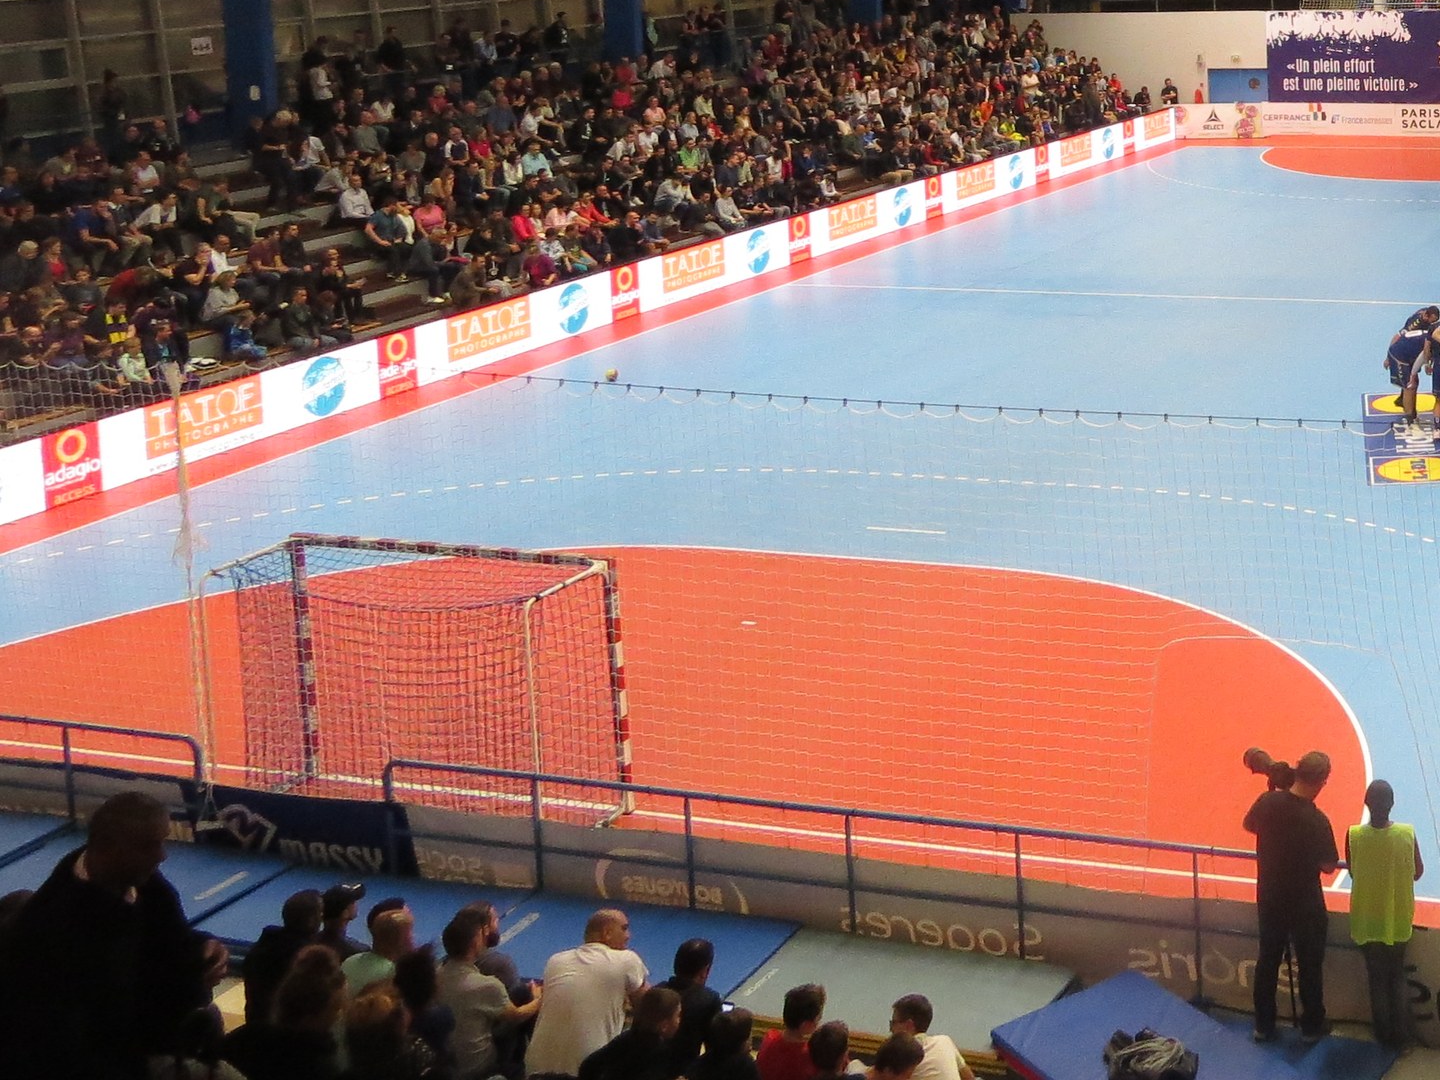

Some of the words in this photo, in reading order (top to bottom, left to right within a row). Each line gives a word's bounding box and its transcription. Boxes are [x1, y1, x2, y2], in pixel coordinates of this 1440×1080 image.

[1314, 58, 1341, 73] plein
[1344, 58, 1375, 73] effort
[1283, 77, 1299, 91] est
[1303, 78, 1323, 91] une
[1327, 76, 1360, 93] pleine
[1401, 108, 1440, 118] PARIS
[830, 198, 875, 229] TATOF
[665, 244, 722, 278] TATOF
[667, 267, 721, 288] PHOTOGRAPHE
[451, 301, 527, 344] TATOF
[453, 328, 526, 355] PHOTOGRAPHE
[151, 382, 255, 437] TATOF
[45, 458, 101, 486] adagio
[54, 484, 96, 505] access
